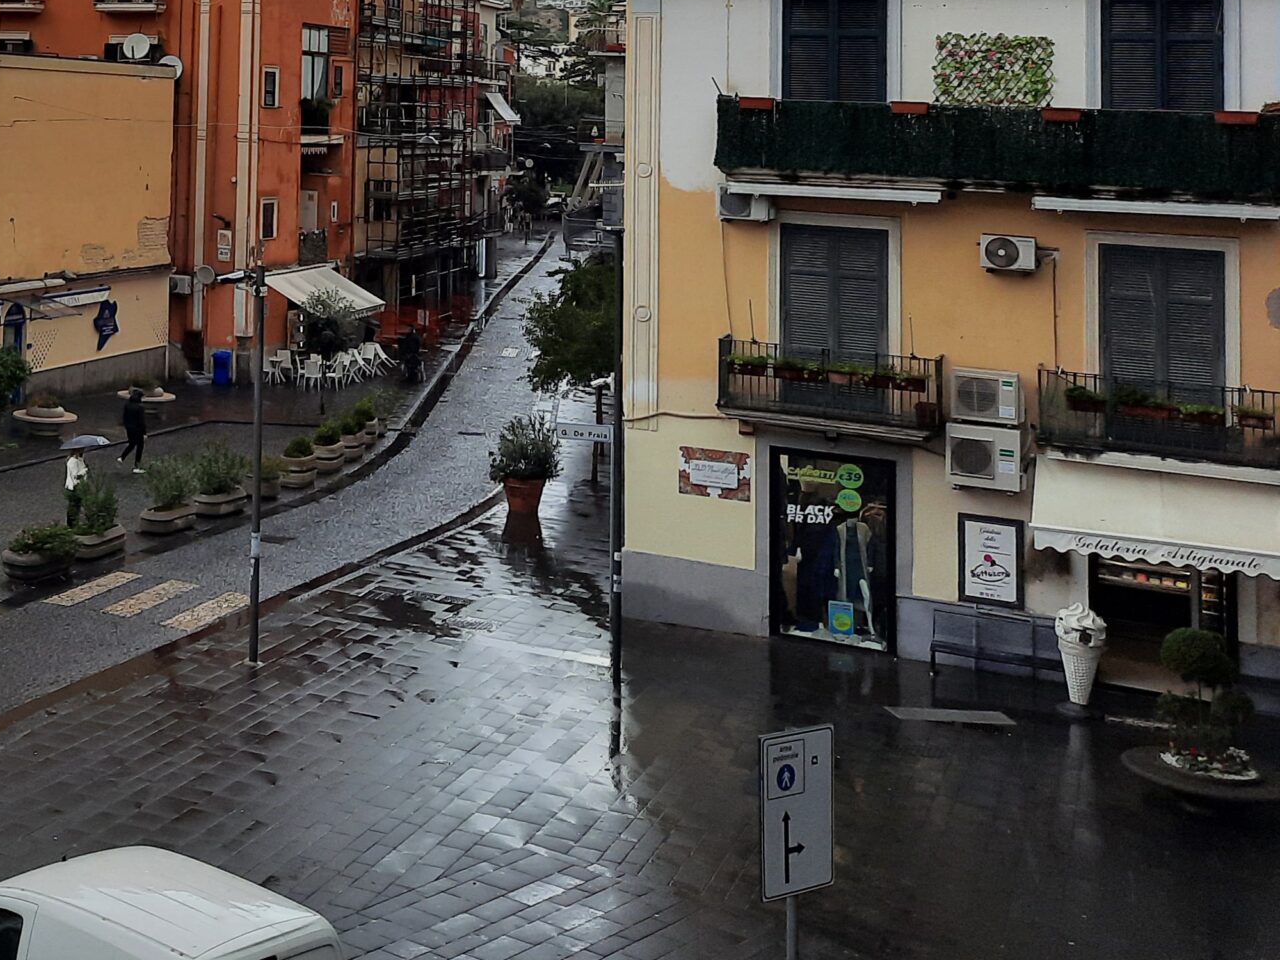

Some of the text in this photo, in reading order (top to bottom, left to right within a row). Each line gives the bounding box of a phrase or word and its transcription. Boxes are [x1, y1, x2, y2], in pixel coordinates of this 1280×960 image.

[573, 430, 585, 438] De
[587, 431, 608, 439] Fraia
[786, 504, 835, 516] BLACK
[1073, 535, 1264, 570] Gelateria Artigianale
